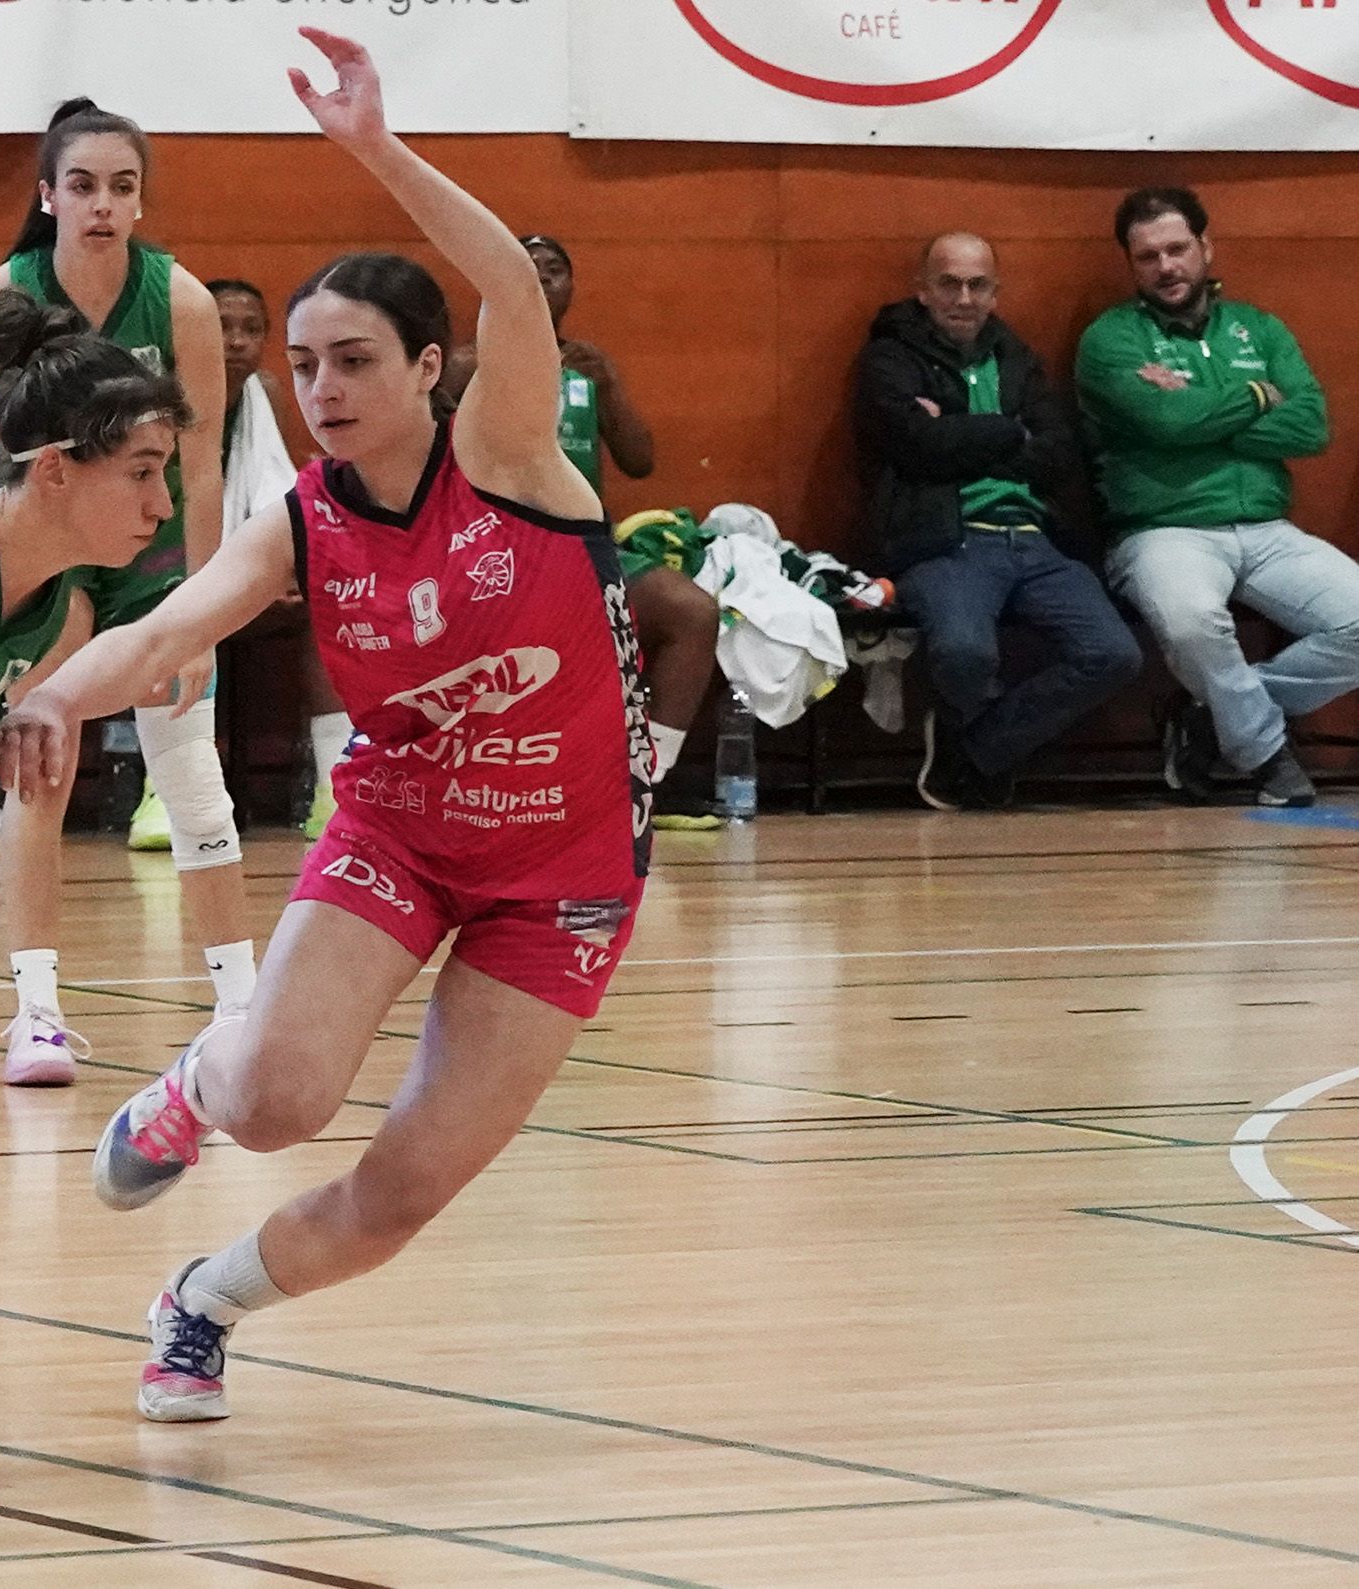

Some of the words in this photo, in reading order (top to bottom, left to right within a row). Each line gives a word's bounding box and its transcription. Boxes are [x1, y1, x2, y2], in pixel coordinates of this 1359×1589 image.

[841, 9, 902, 40] CAFÉ
[407, 577, 448, 648] 9
[442, 778, 564, 813] Asturias
[506, 808, 566, 824] natural
